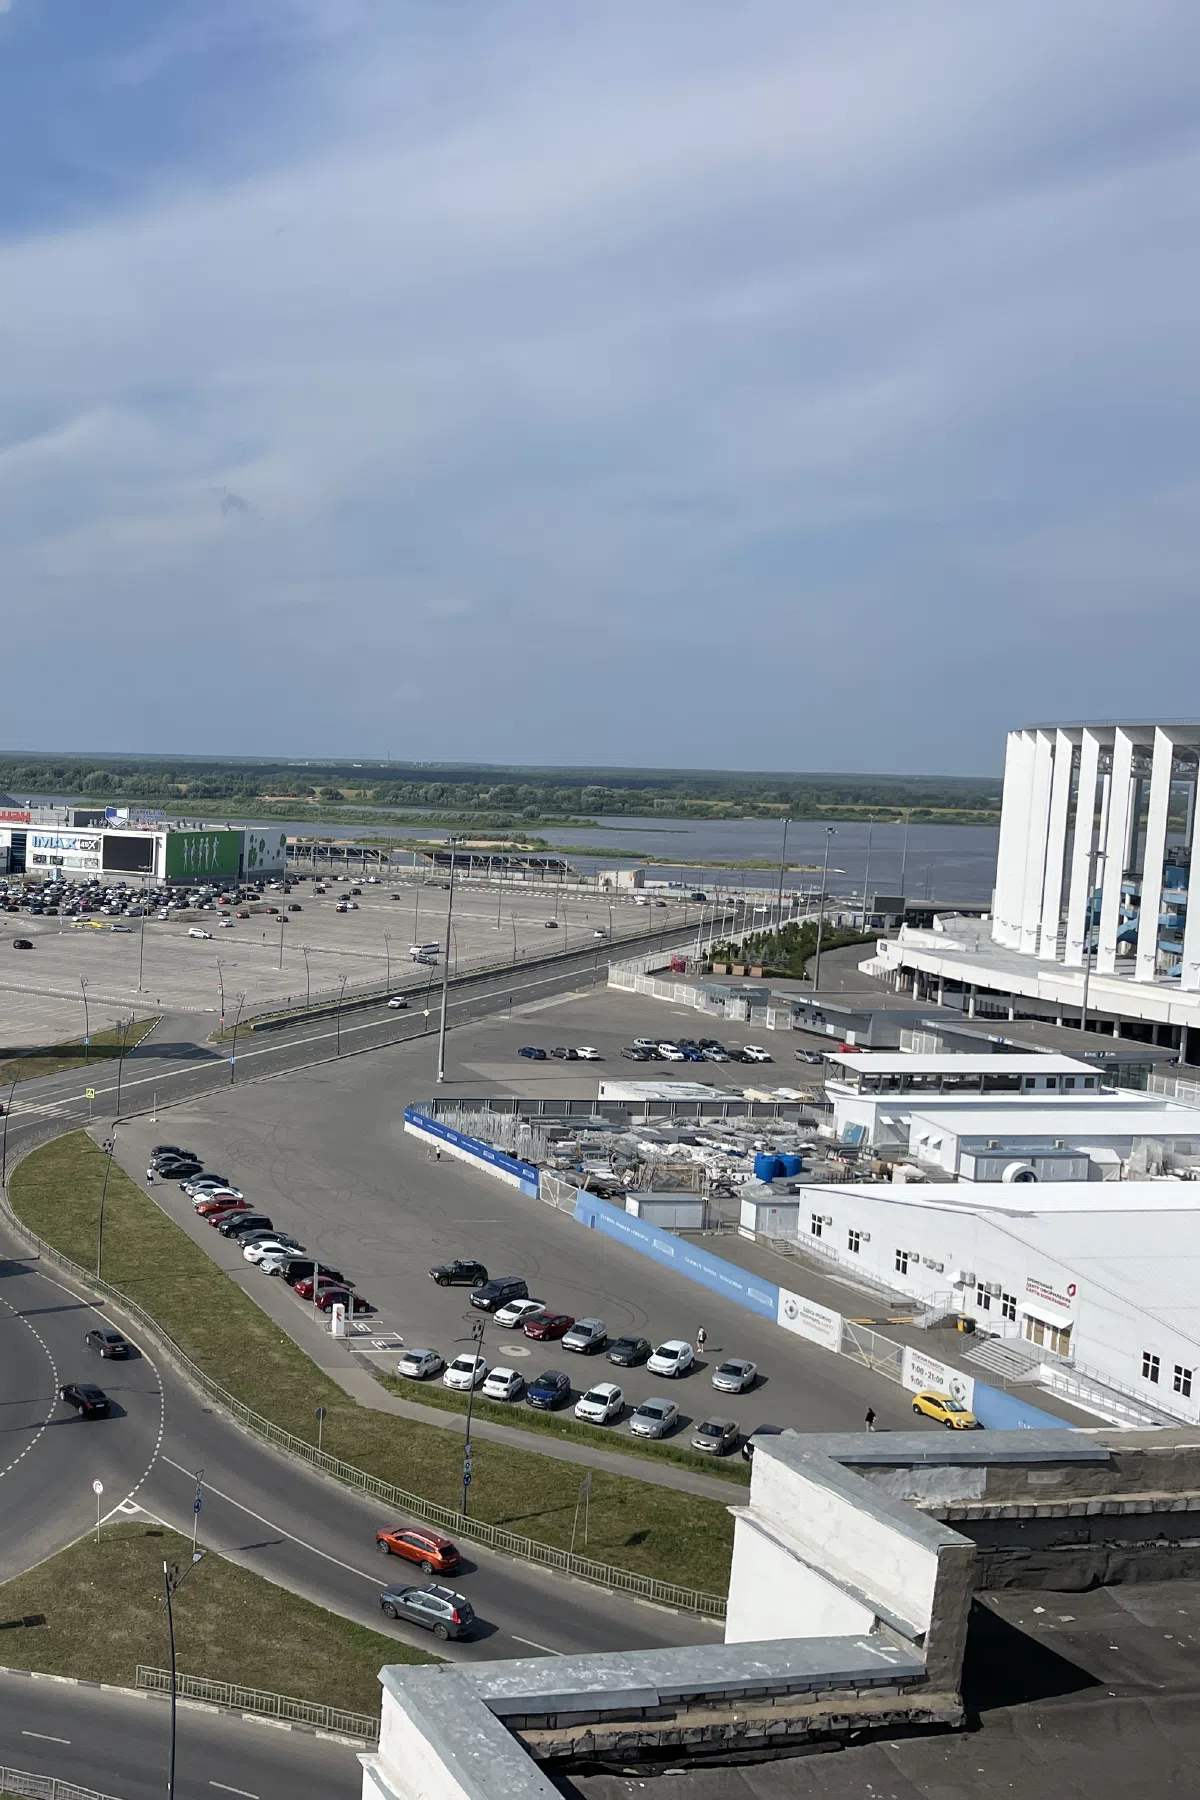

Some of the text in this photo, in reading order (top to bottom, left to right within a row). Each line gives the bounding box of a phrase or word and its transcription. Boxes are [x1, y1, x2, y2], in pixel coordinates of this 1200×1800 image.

[31, 835, 79, 850] IMAX
[910, 1374, 924, 1388] 9:00
[911, 1362, 925, 1376] 9:00
[927, 1371, 944, 1385] 21:00
